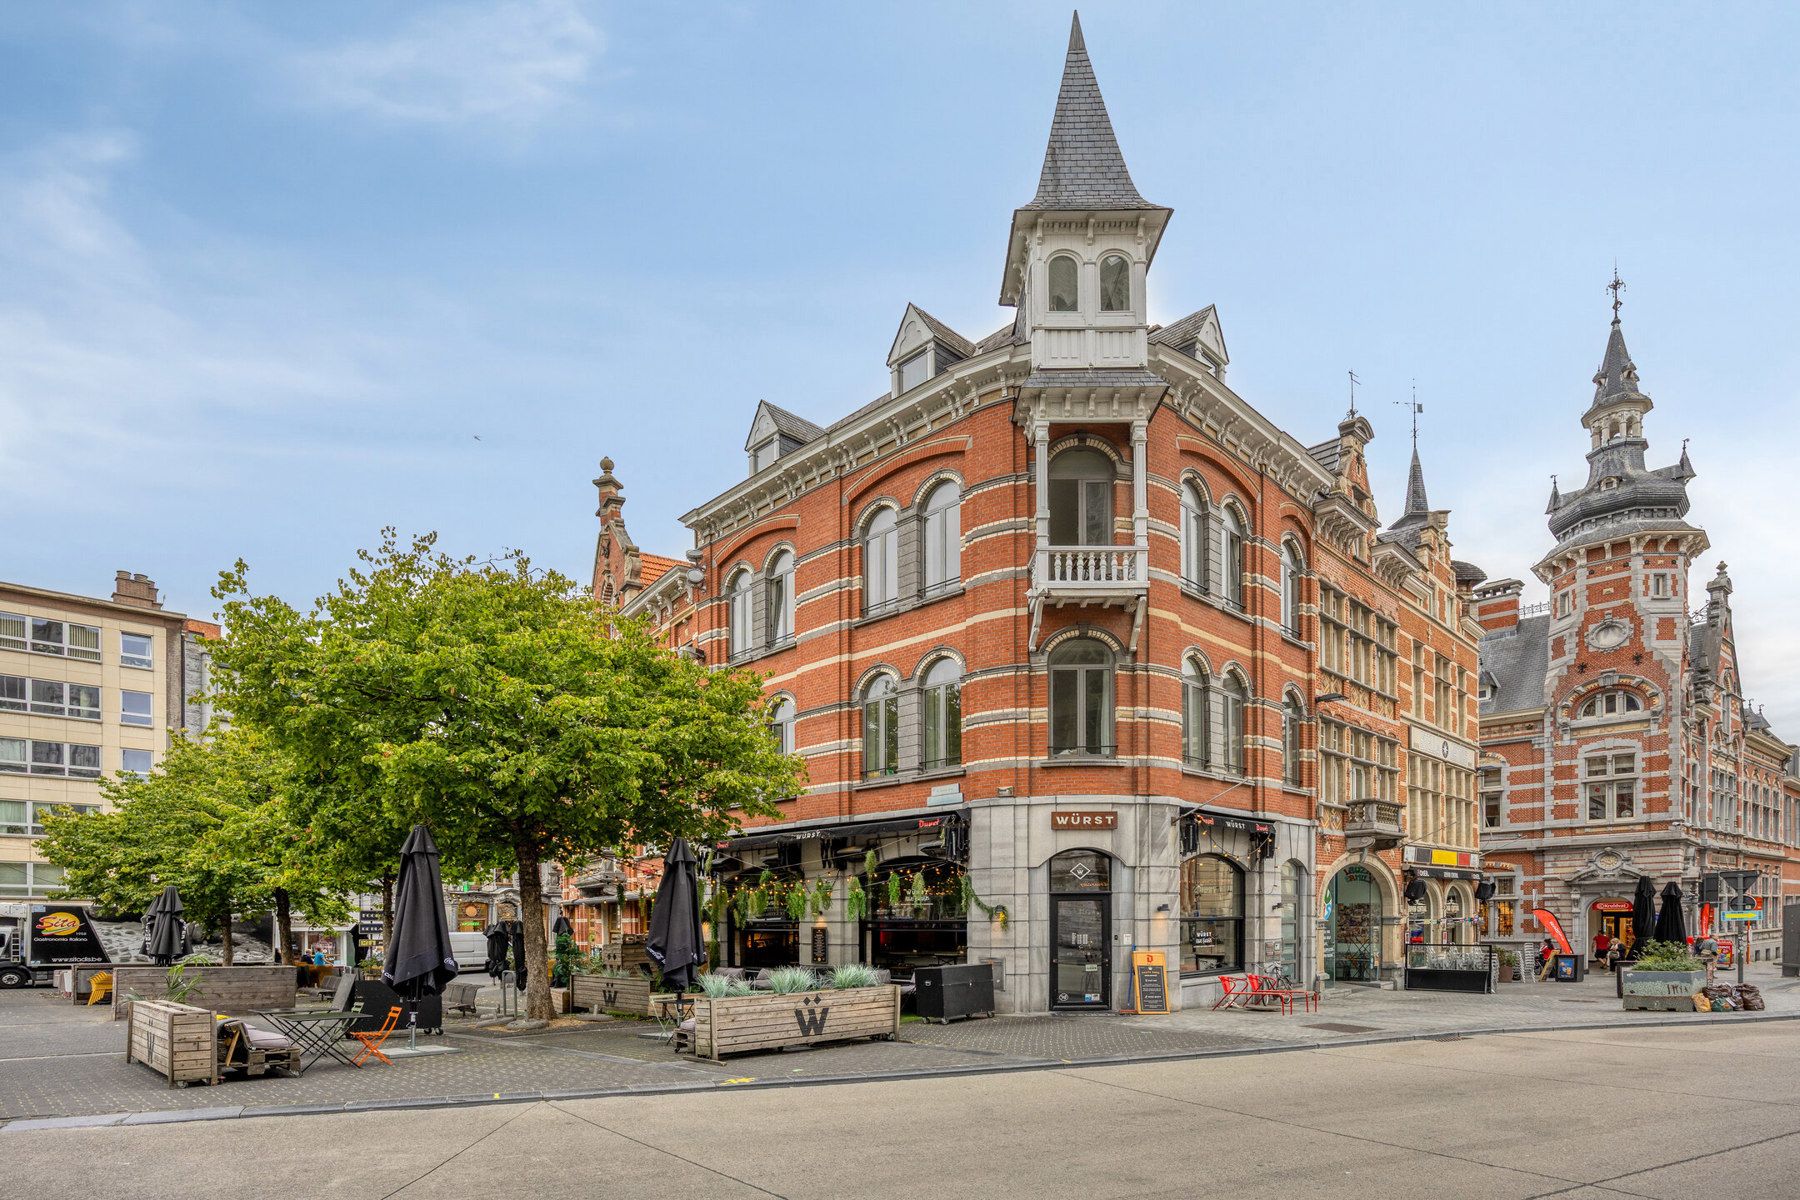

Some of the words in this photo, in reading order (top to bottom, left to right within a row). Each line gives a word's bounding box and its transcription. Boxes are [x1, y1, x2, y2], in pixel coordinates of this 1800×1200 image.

[918, 818, 941, 828] Duvel
[1056, 813, 1114, 825] WÜRST
[1225, 820, 1246, 829] WÜRST
[36, 915, 77, 930] Sita
